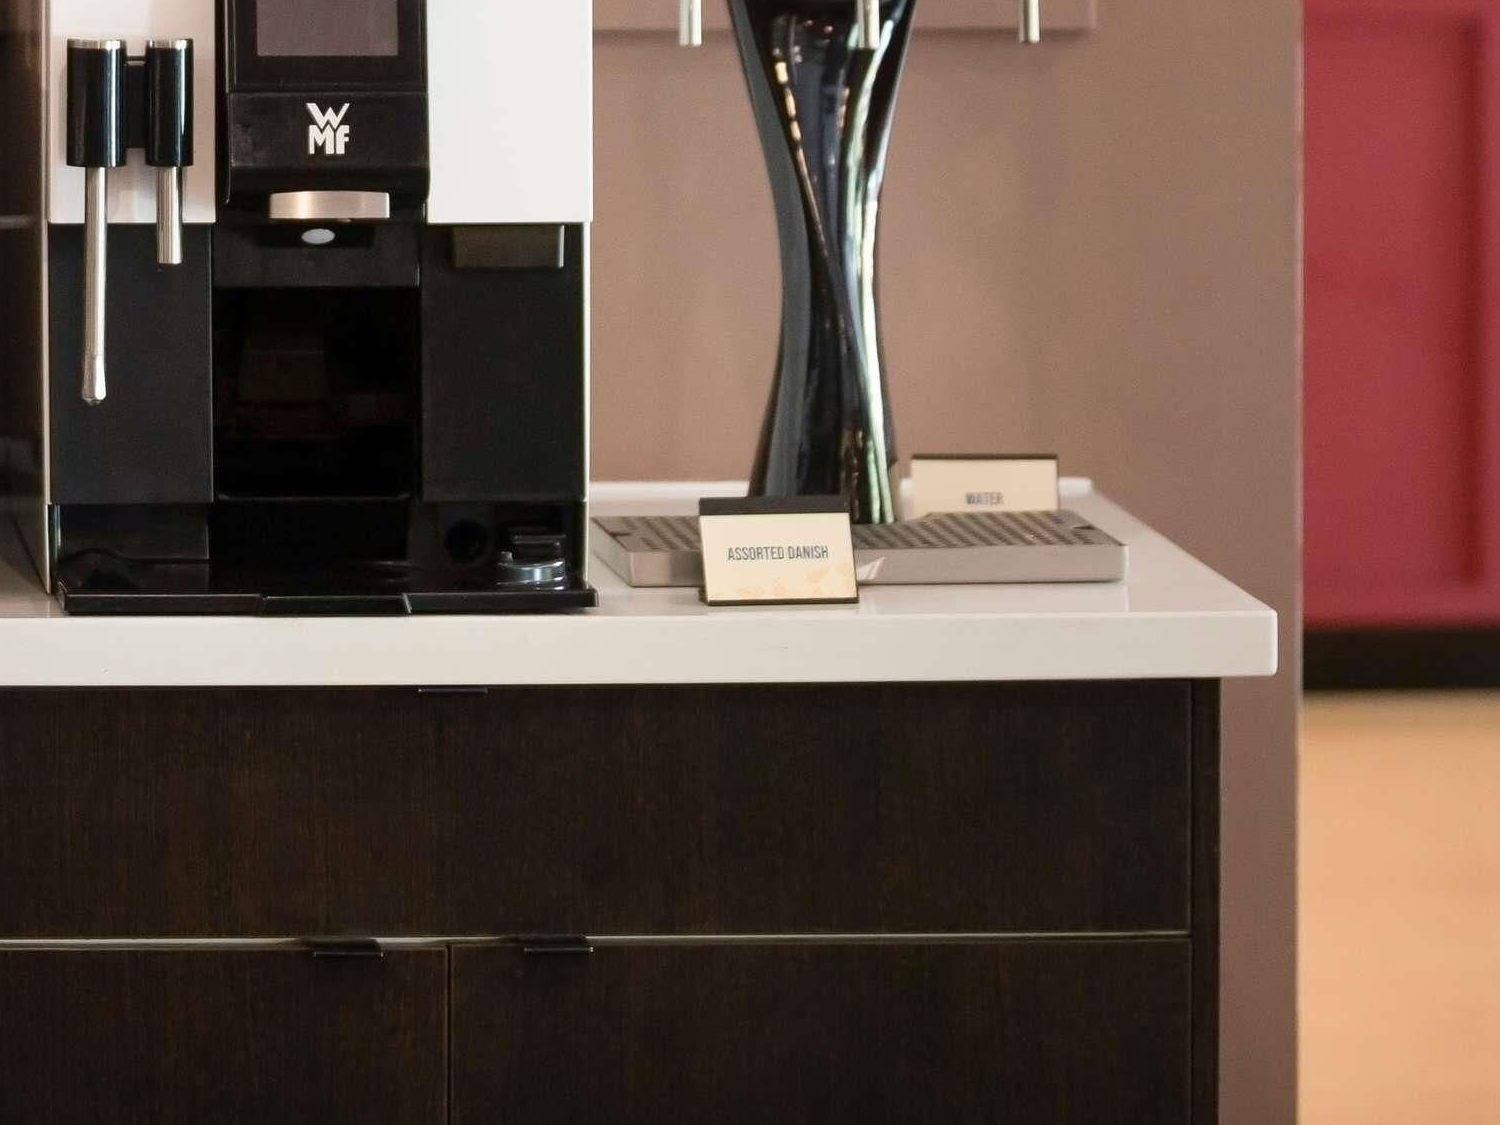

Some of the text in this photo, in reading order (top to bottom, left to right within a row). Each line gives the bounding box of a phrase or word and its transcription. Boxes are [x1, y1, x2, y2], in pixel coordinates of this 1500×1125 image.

[306, 103, 350, 155] WMF
[965, 491, 1004, 505] WATER
[728, 545, 828, 561] ASSORTED DANISH
